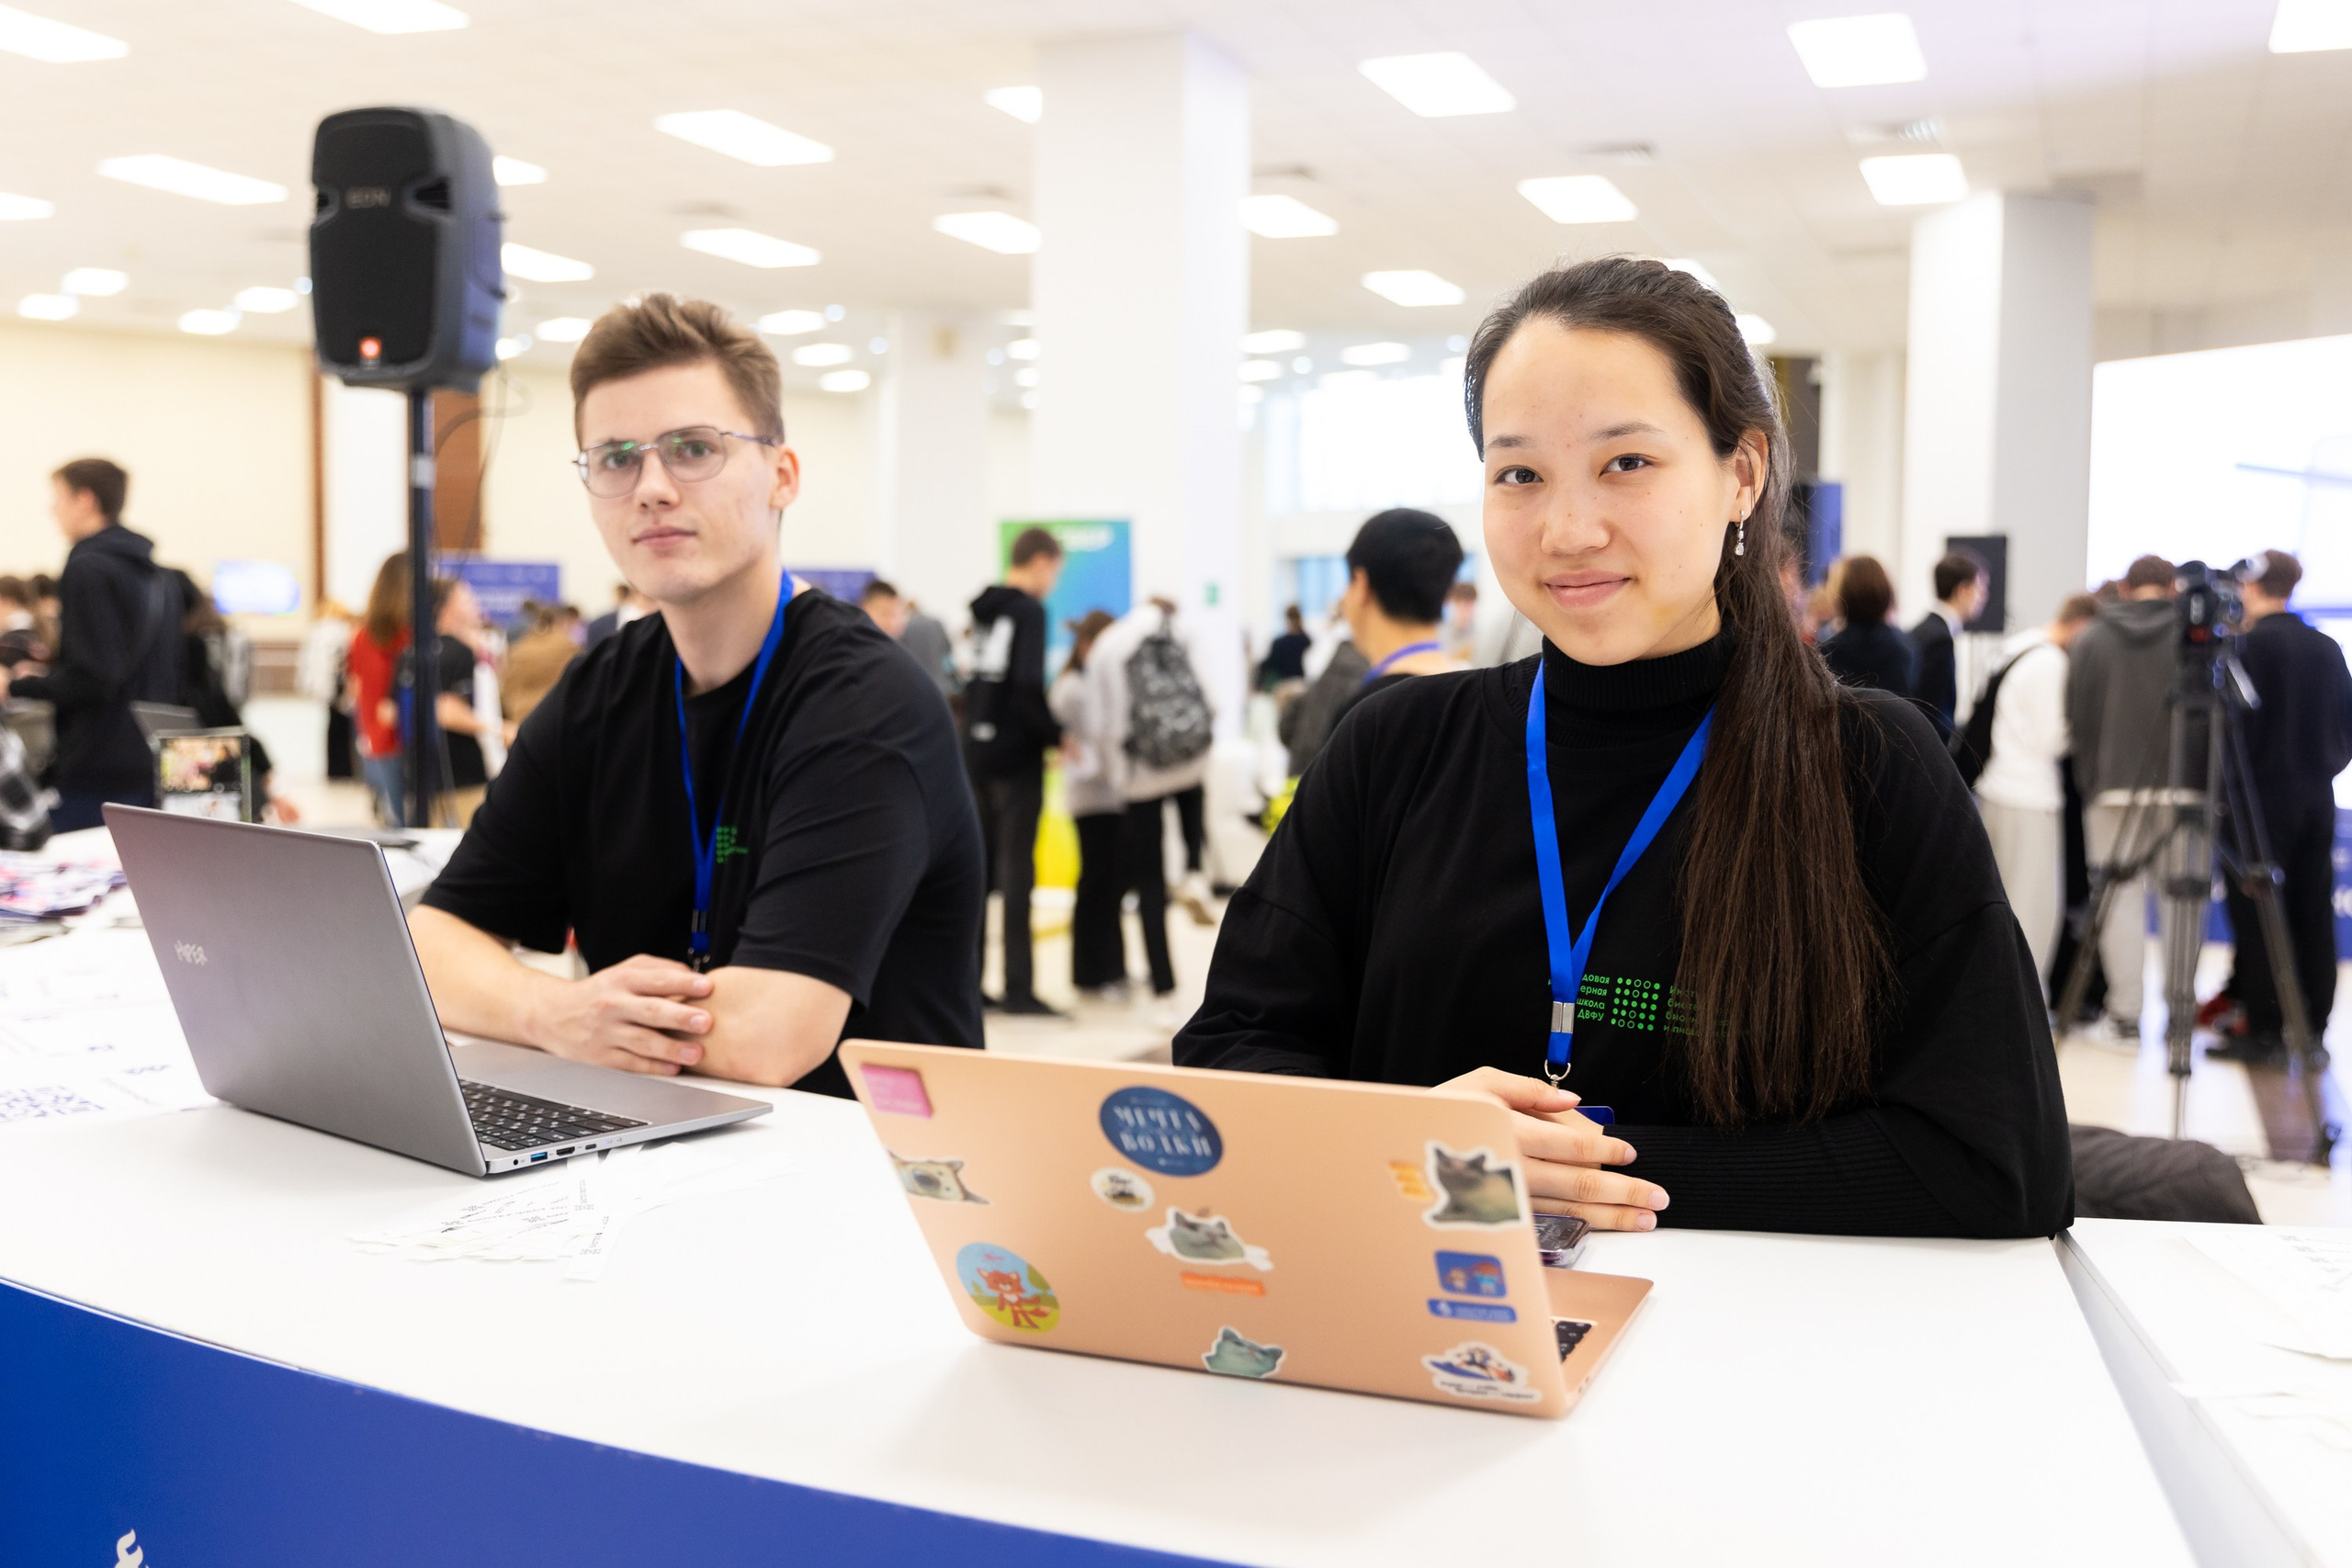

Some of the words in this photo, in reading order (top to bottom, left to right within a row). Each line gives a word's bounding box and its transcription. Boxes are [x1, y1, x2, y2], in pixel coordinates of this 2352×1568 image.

[1581, 974, 1611, 985] довая
[1576, 998, 1606, 1010] школа
[1577, 1009, 1605, 1022] ДВФУ
